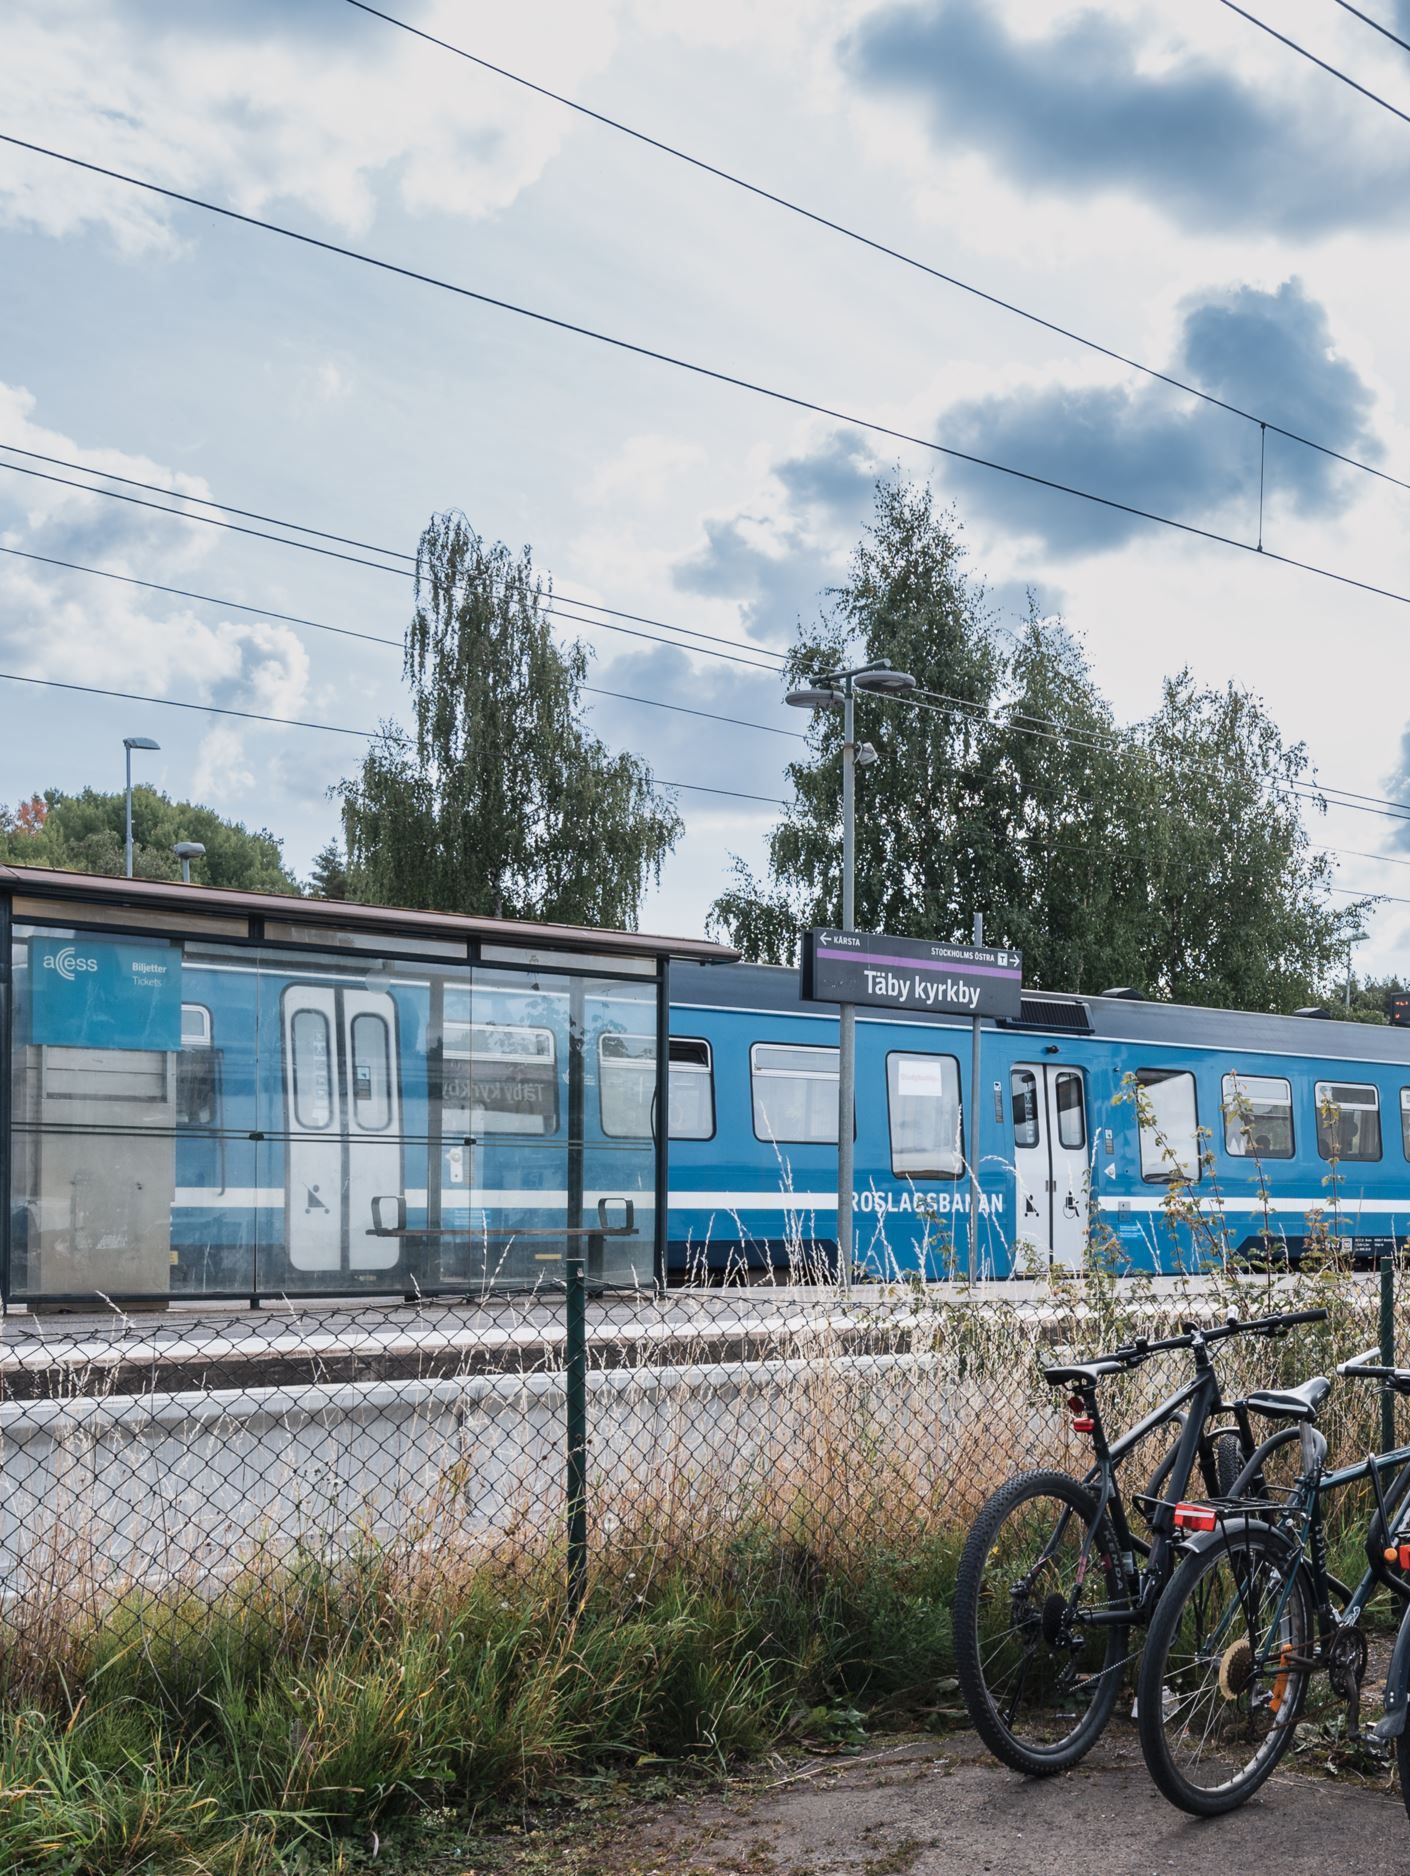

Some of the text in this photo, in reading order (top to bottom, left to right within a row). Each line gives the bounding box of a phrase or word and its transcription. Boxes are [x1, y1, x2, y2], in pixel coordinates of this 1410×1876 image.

[833, 936, 860, 946] KÅRSTA
[931, 947, 974, 960] STOCKHOLMS
[975, 951, 995, 962] ÖSTRA
[132, 962, 167, 974] Biljetter
[133, 976, 162, 986] Tickets
[864, 970, 981, 1009] Täby kyrkby
